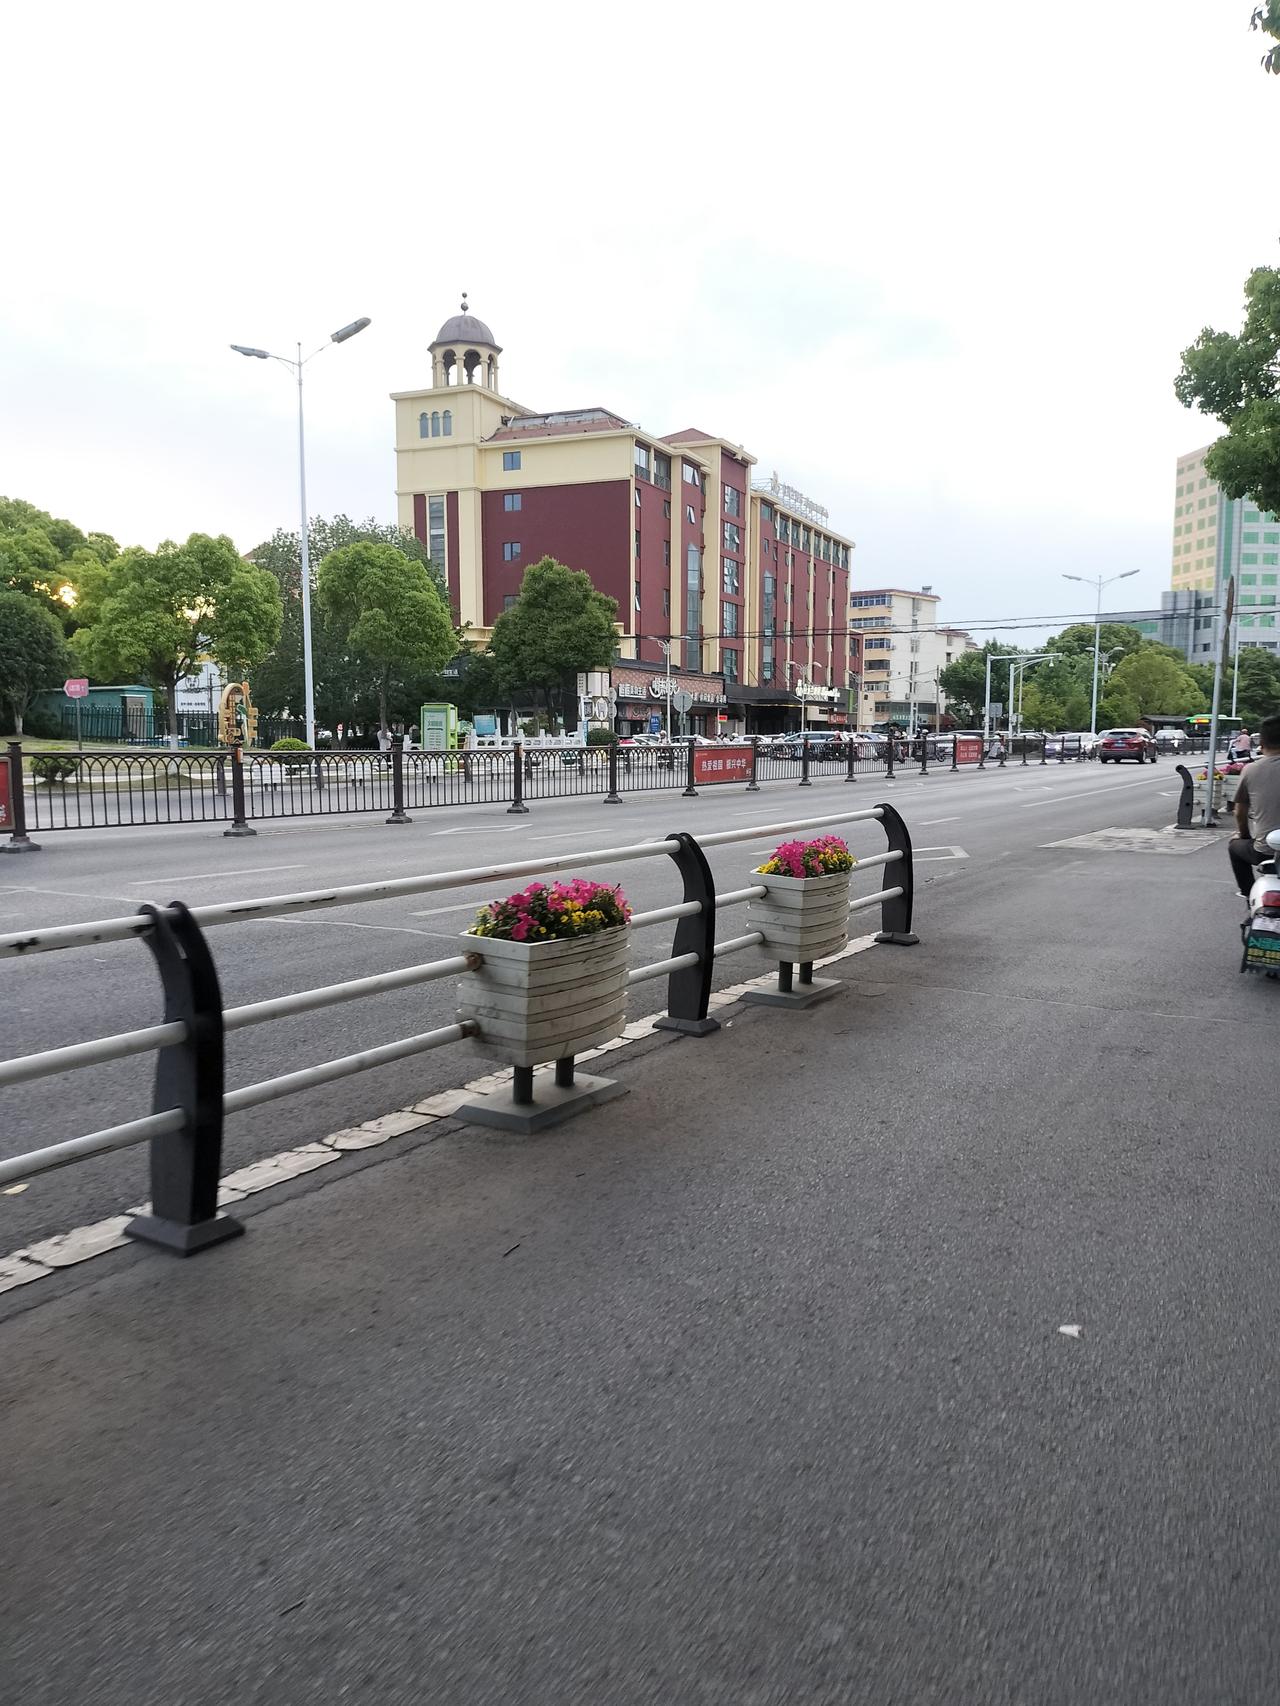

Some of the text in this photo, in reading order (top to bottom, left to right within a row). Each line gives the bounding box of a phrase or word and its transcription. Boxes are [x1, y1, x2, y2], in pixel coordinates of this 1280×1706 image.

[701, 758, 746, 771] 热爱祖国 振兴中华
